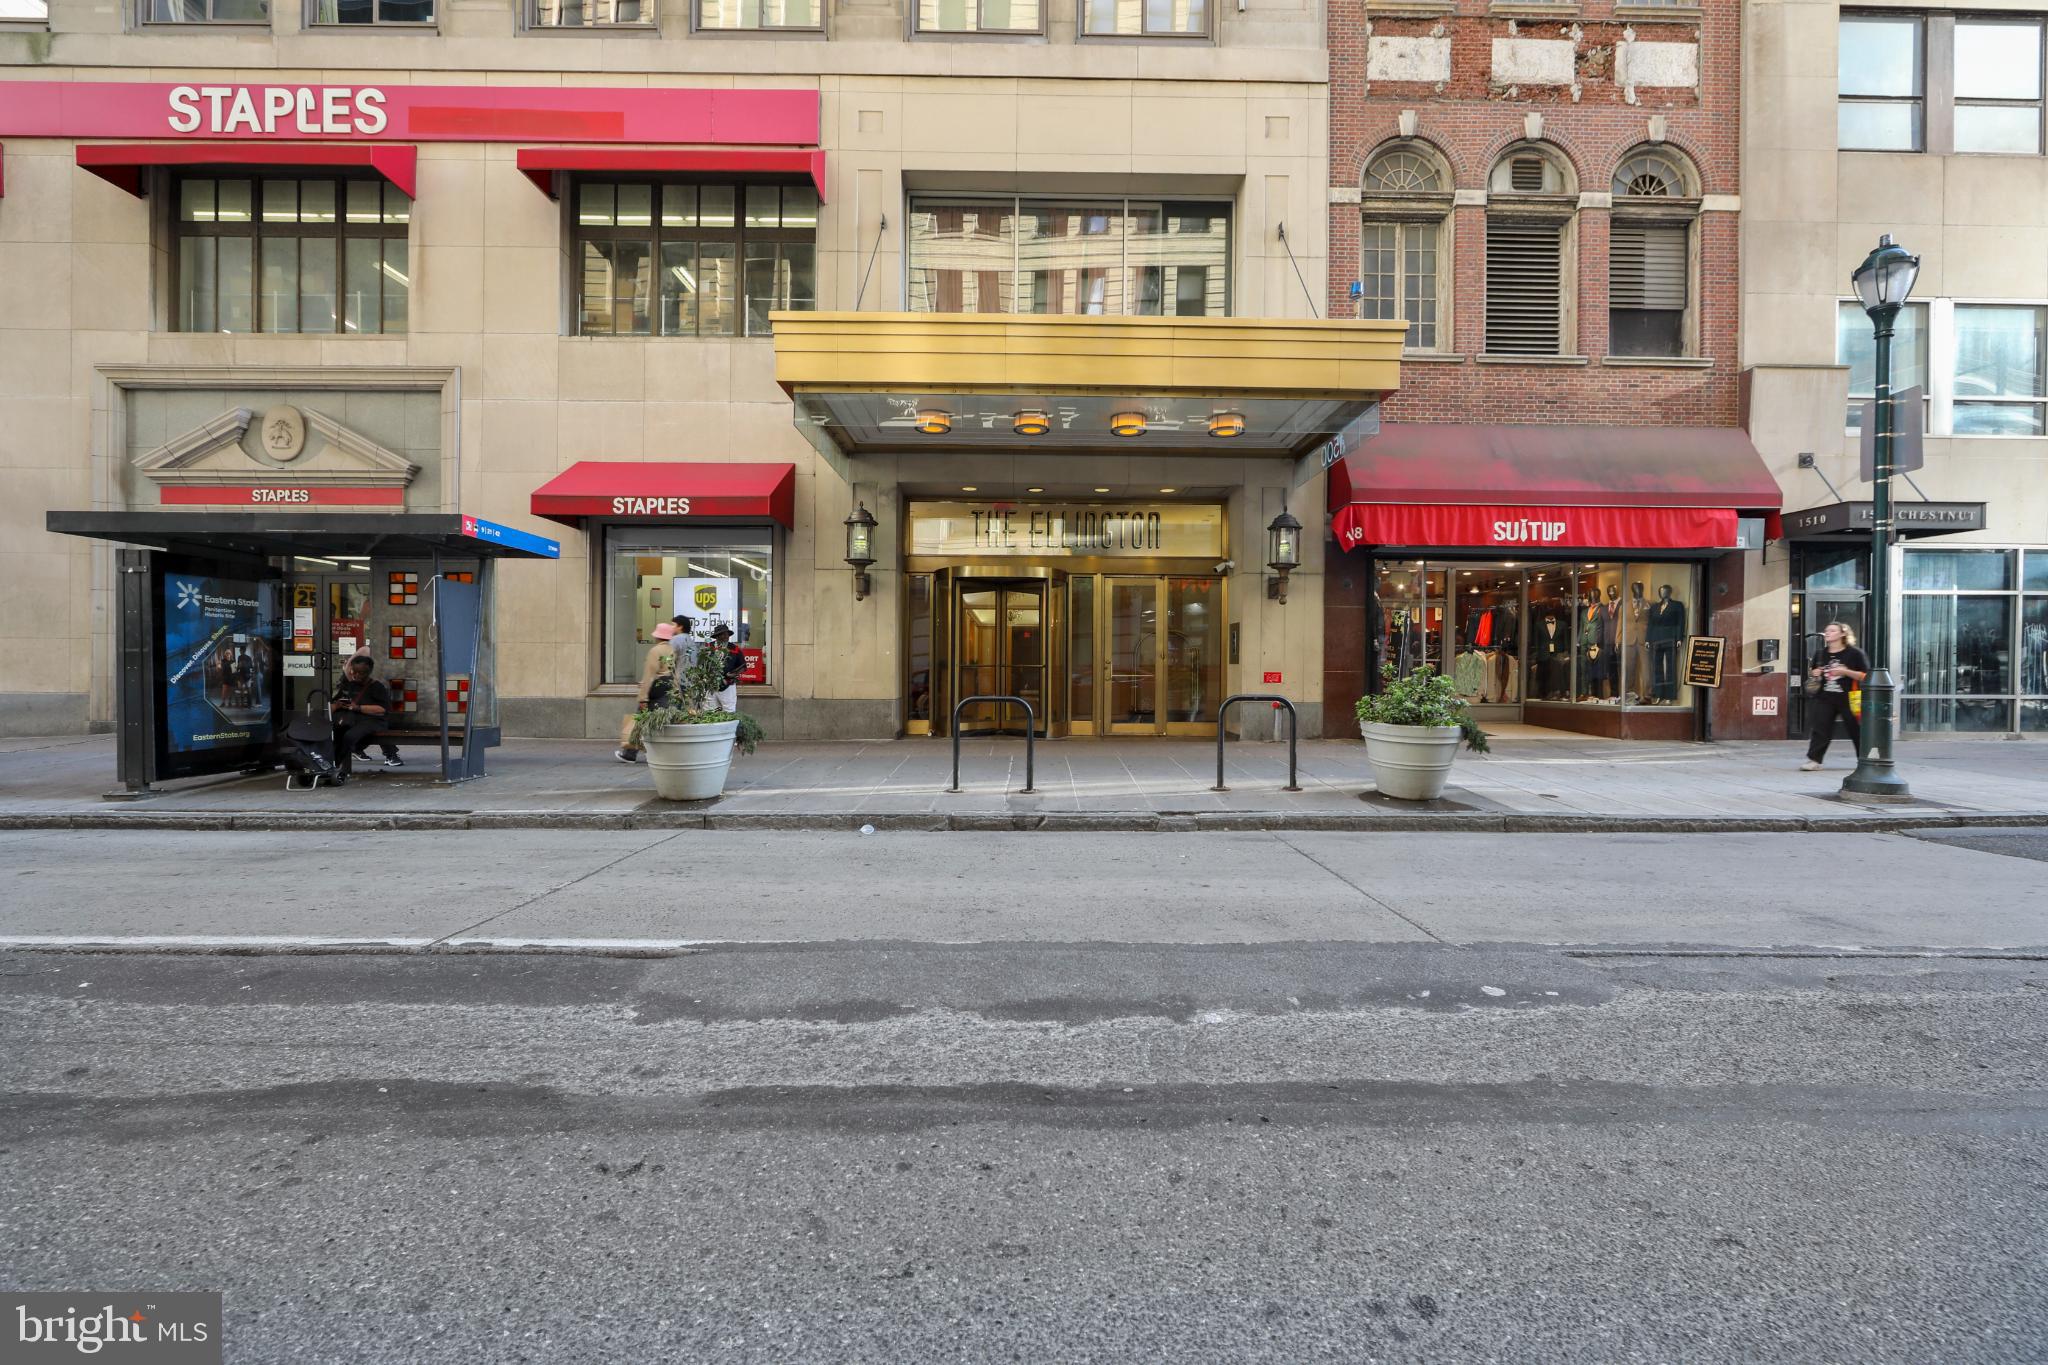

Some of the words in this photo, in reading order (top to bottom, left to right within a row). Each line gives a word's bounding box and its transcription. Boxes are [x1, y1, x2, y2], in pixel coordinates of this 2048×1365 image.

[168, 86, 387, 134] STAPLES
[251, 489, 309, 502] STAPLES
[612, 497, 690, 514] STAPLES
[1799, 514, 1827, 527] 1510
[1898, 510, 1977, 521] CHESTNUT
[971, 511, 1017, 548] THE
[1029, 511, 1161, 549] ELLINGTON
[1493, 518, 1566, 542] SUITUP
[204, 595, 236, 605] Eastern
[238, 598, 259, 607] State
[696, 592, 716, 608] ups
[702, 618, 708, 626] 7
[1754, 699, 1775, 710] FDC
